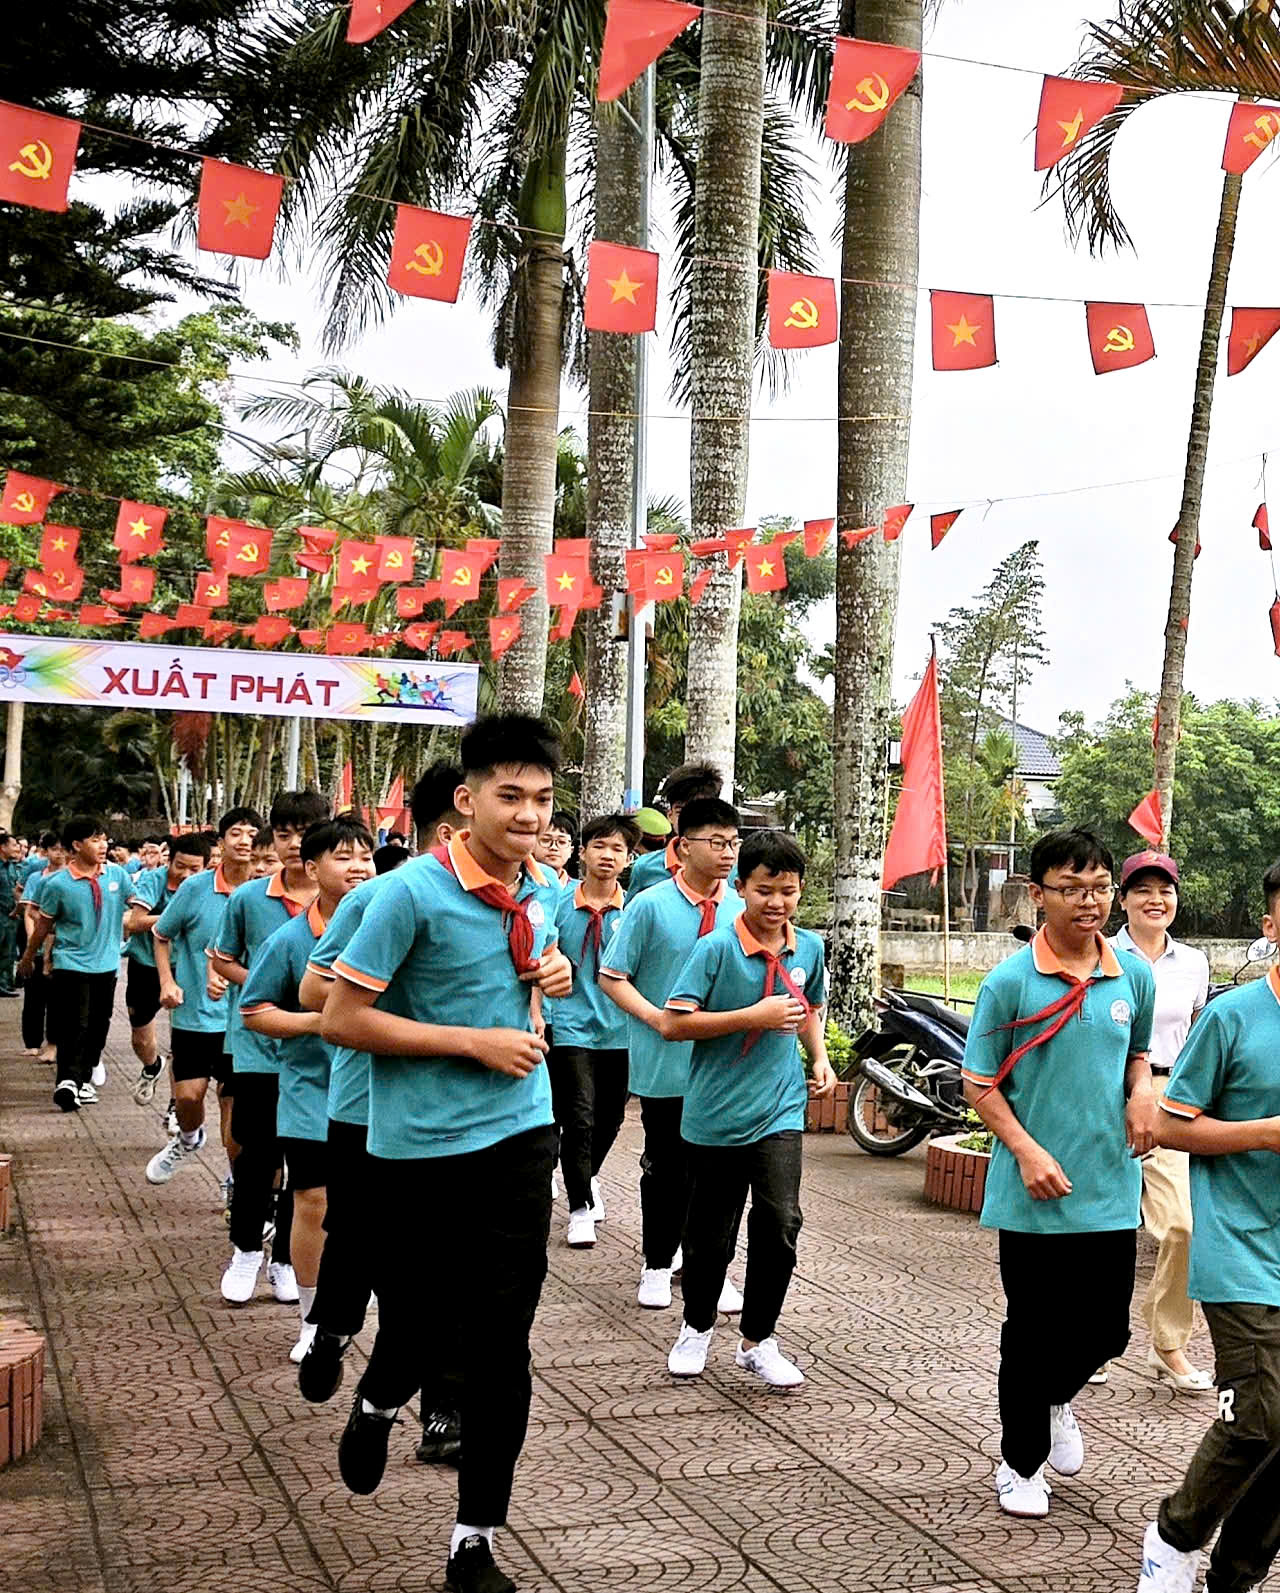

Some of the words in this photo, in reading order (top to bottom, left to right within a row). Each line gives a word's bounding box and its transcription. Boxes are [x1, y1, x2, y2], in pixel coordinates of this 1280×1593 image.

[102, 658, 217, 699] XUẤT
[230, 672, 339, 706] PHÁT
[1218, 1387, 1236, 1423] R
